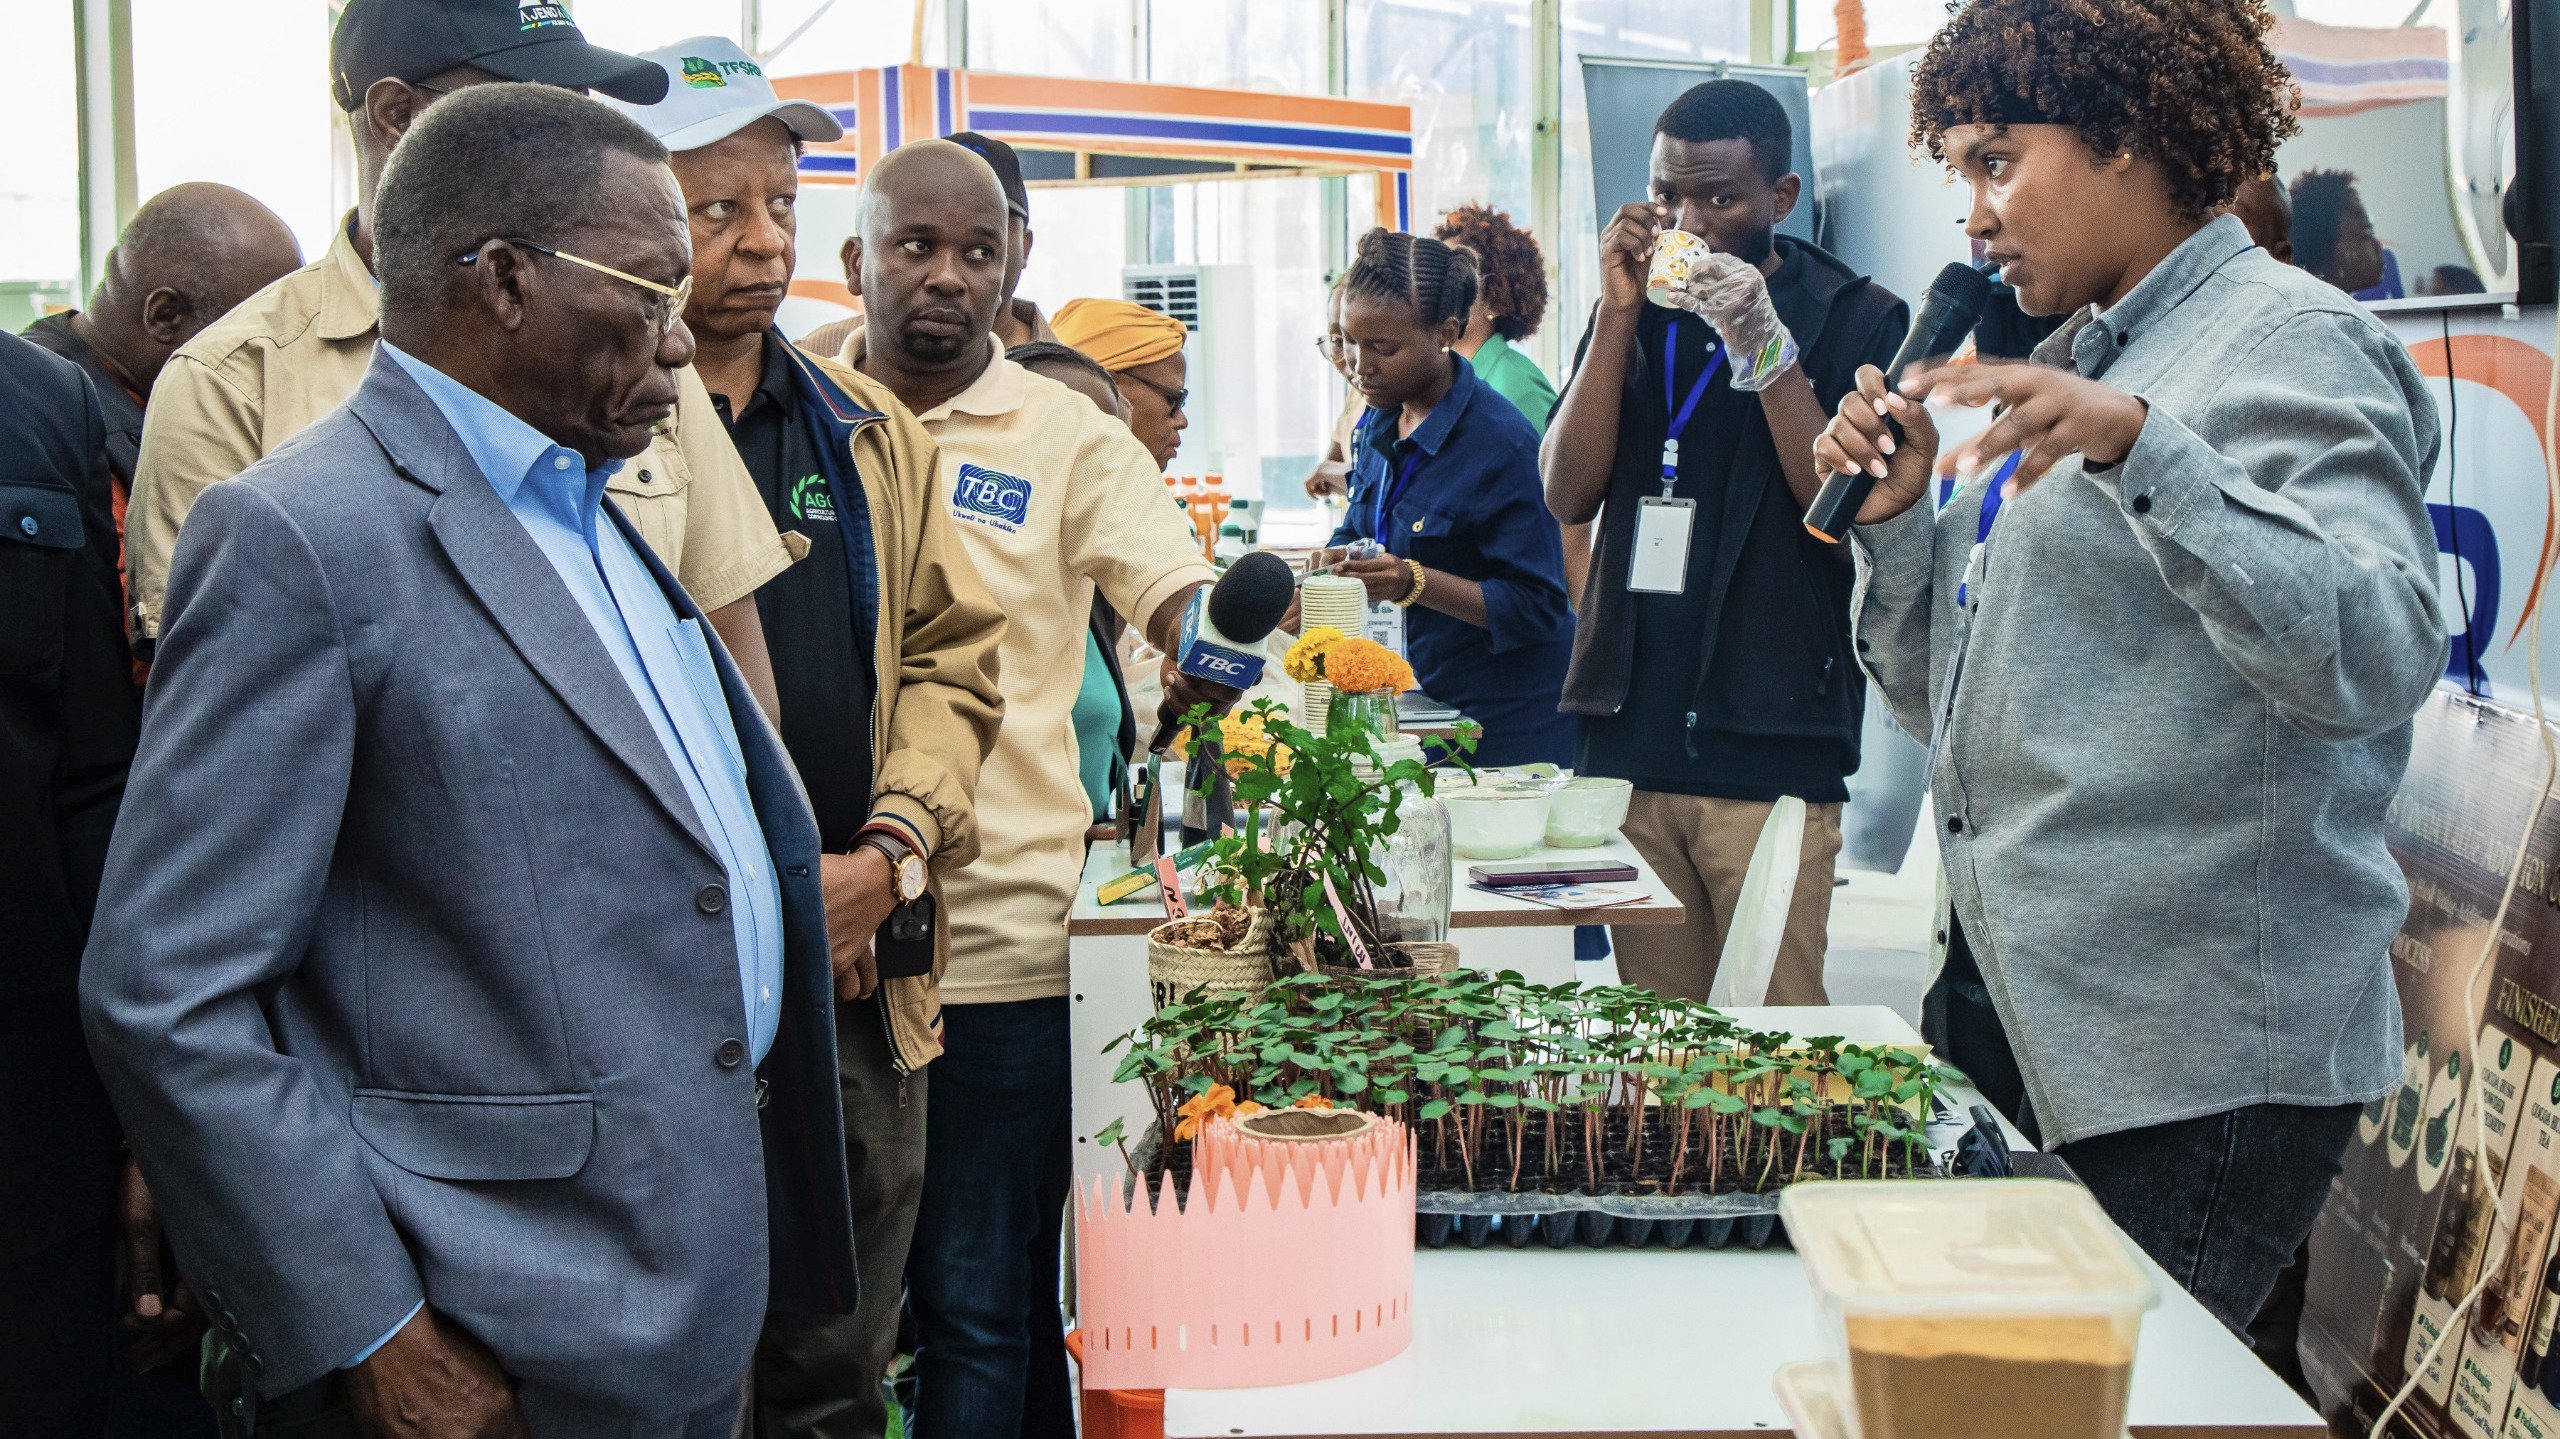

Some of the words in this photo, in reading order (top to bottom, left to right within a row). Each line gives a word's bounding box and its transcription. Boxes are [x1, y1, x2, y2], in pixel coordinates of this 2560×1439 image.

[962, 475, 1024, 511] TBC
[1184, 601, 1196, 645] TBC
[1197, 653, 1246, 676] TBC
